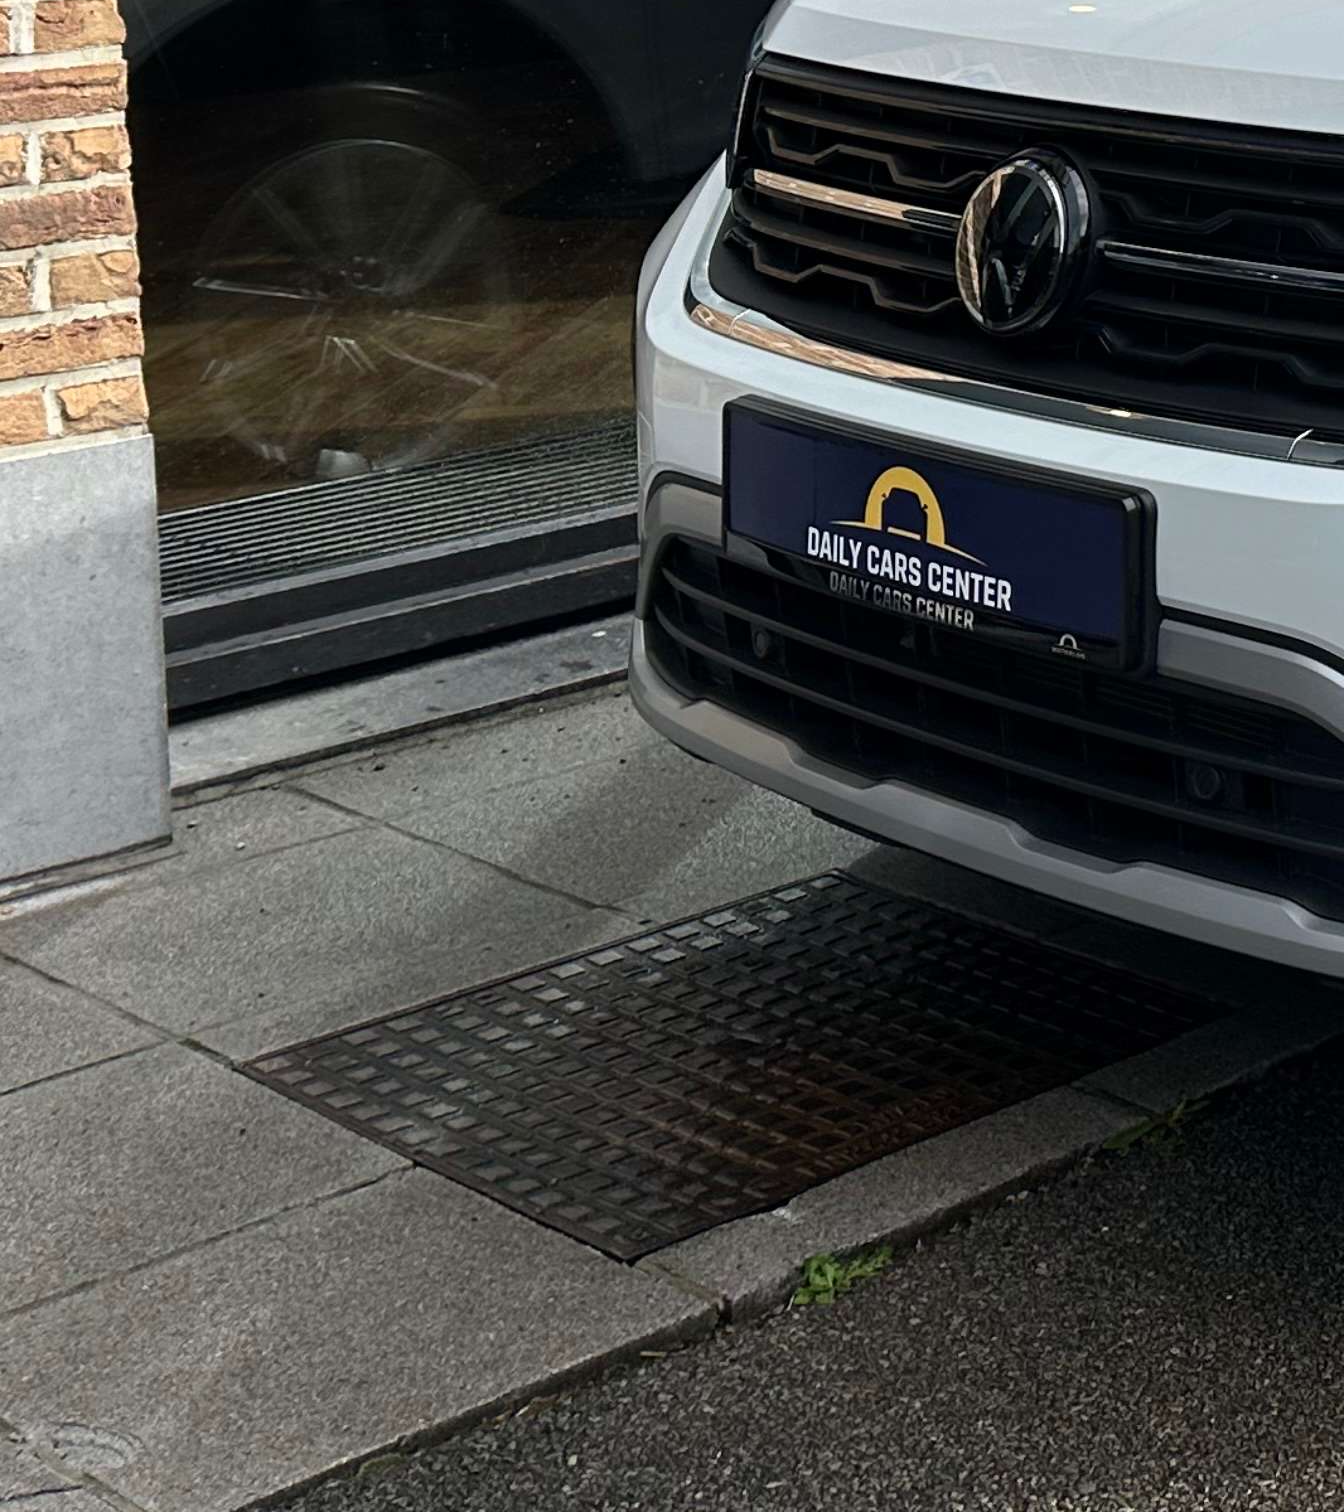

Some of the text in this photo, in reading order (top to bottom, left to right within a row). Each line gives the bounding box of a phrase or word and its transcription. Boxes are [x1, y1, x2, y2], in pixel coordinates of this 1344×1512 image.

[807, 526, 1011, 611] DAILY CARS CENTER
[829, 570, 975, 631] DAILY CARS CENTER
